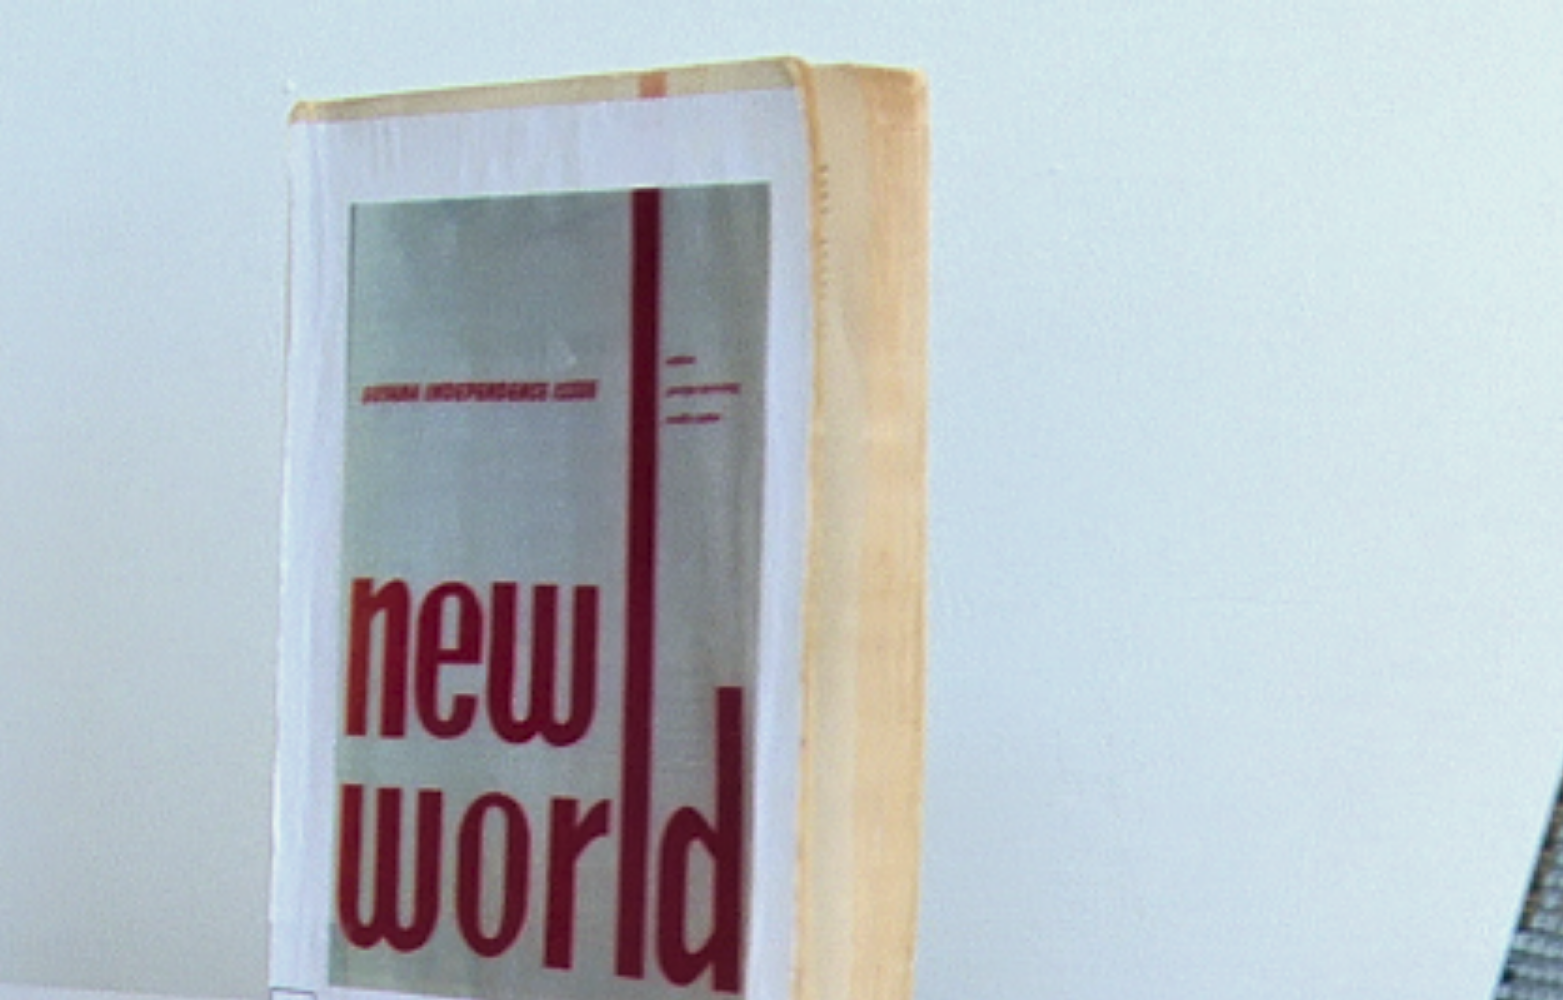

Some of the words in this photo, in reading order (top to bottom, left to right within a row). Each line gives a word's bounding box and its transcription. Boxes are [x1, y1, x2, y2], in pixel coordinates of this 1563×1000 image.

[424, 382, 549, 403] INDEPENDENCE
[553, 379, 599, 400] ISSUE
[345, 576, 600, 748] new
